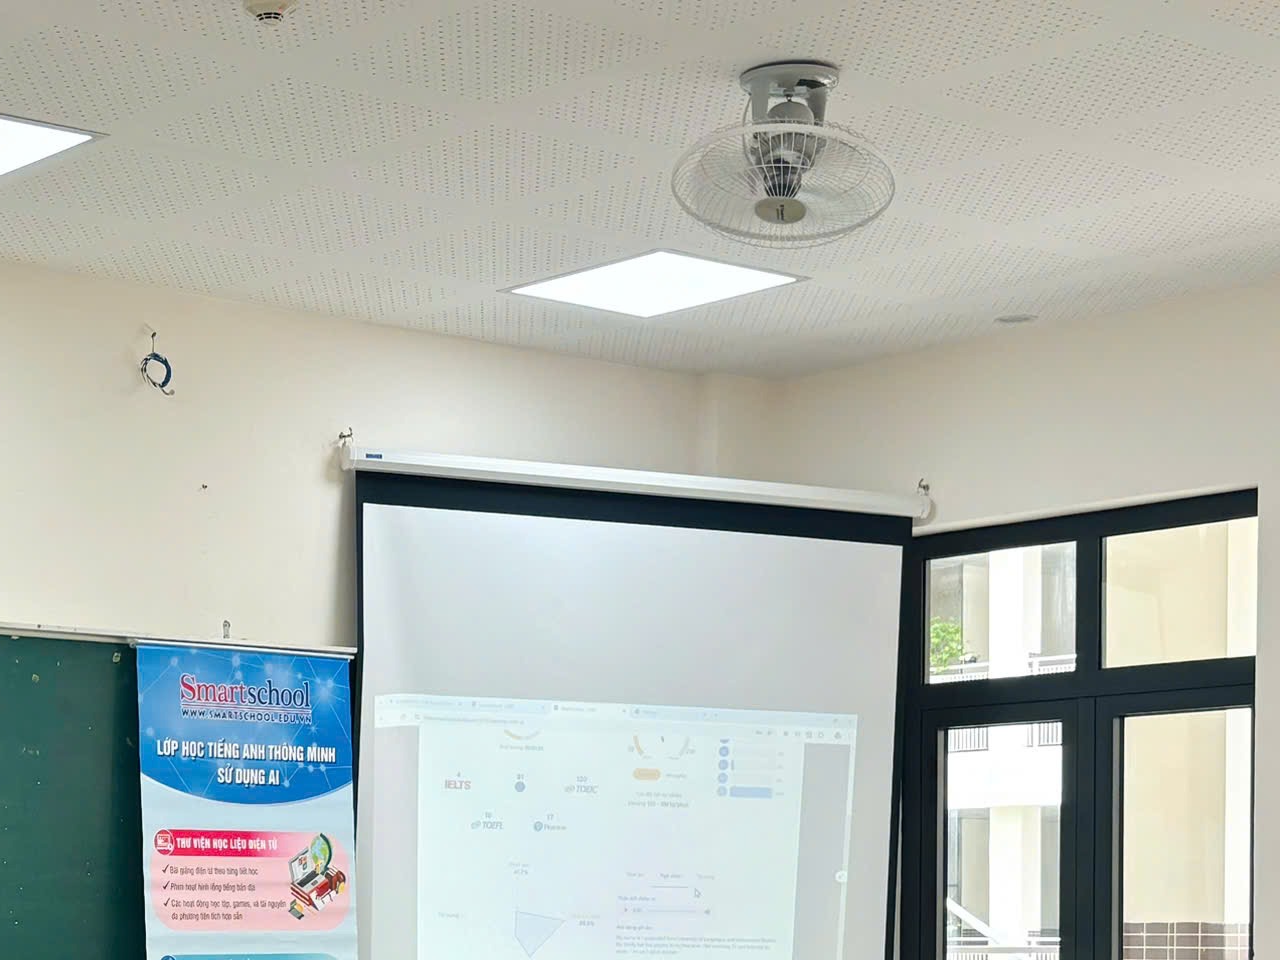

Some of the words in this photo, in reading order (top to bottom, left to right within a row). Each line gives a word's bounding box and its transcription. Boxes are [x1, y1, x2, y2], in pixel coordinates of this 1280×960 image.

[181, 674, 311, 707] Smartschool
[157, 737, 177, 755] LỚP
[182, 741, 204, 760] HỌC
[208, 738, 239, 759] TIẾNG
[243, 744, 265, 760] ANH
[268, 742, 304, 762] THÔNG
[307, 747, 335, 762] MINH
[218, 765, 233, 784] SỬ
[236, 770, 265, 788] DỤNG
[268, 770, 280, 785] AI
[444, 780, 471, 790] IELTS
[193, 836, 210, 850] VIỆN
[213, 838, 228, 850] HỌC
[230, 837, 246, 851] LIỆU
[249, 868, 258, 876] học
[185, 883, 197, 891] hoạt
[211, 900, 220, 908] học
